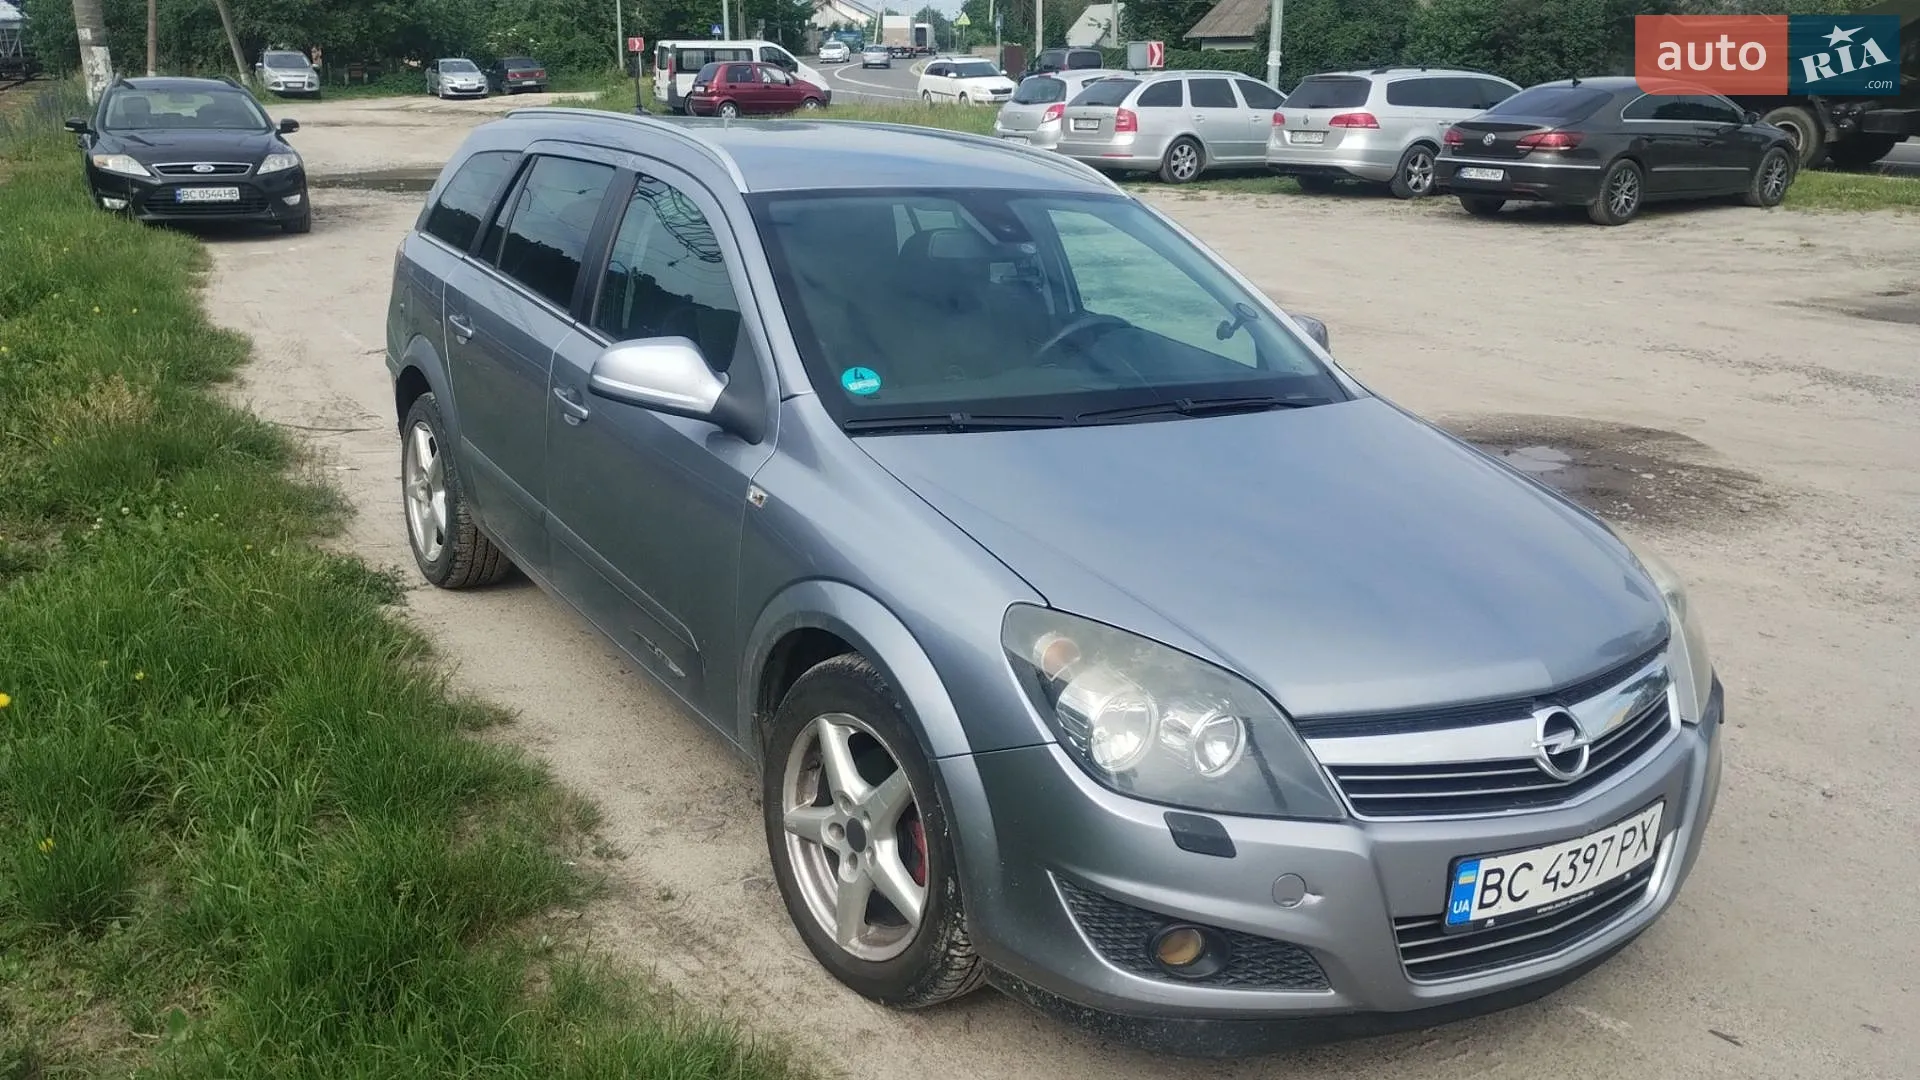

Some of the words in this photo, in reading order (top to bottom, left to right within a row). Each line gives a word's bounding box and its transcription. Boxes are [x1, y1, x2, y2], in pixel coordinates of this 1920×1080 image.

[182, 190, 196, 199] BC
[199, 190, 222, 199] 0544
[1477, 862, 1534, 910] BC
[1542, 838, 1615, 892] 4397
[1615, 814, 1656, 868] PX
[1453, 899, 1470, 914] UA
